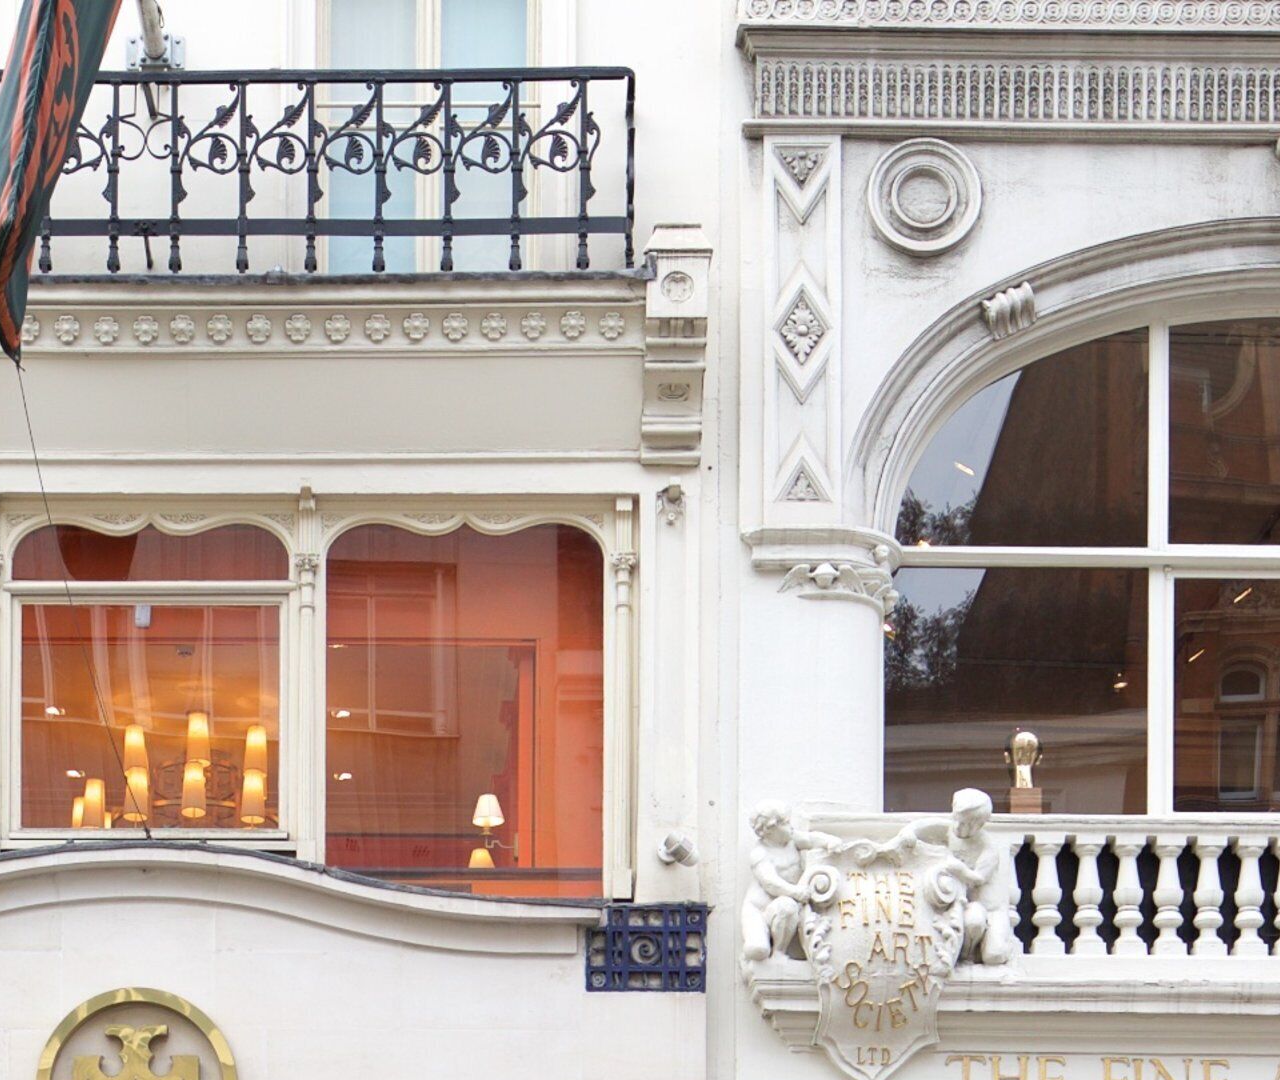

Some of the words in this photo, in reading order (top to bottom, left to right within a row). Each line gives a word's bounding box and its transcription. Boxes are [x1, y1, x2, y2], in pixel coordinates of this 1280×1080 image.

[846, 871, 914, 898] THE
[838, 896, 915, 929] FINE
[868, 932, 934, 966] ART
[831, 961, 931, 1032] SOCIETY
[857, 1047, 891, 1065] LTD
